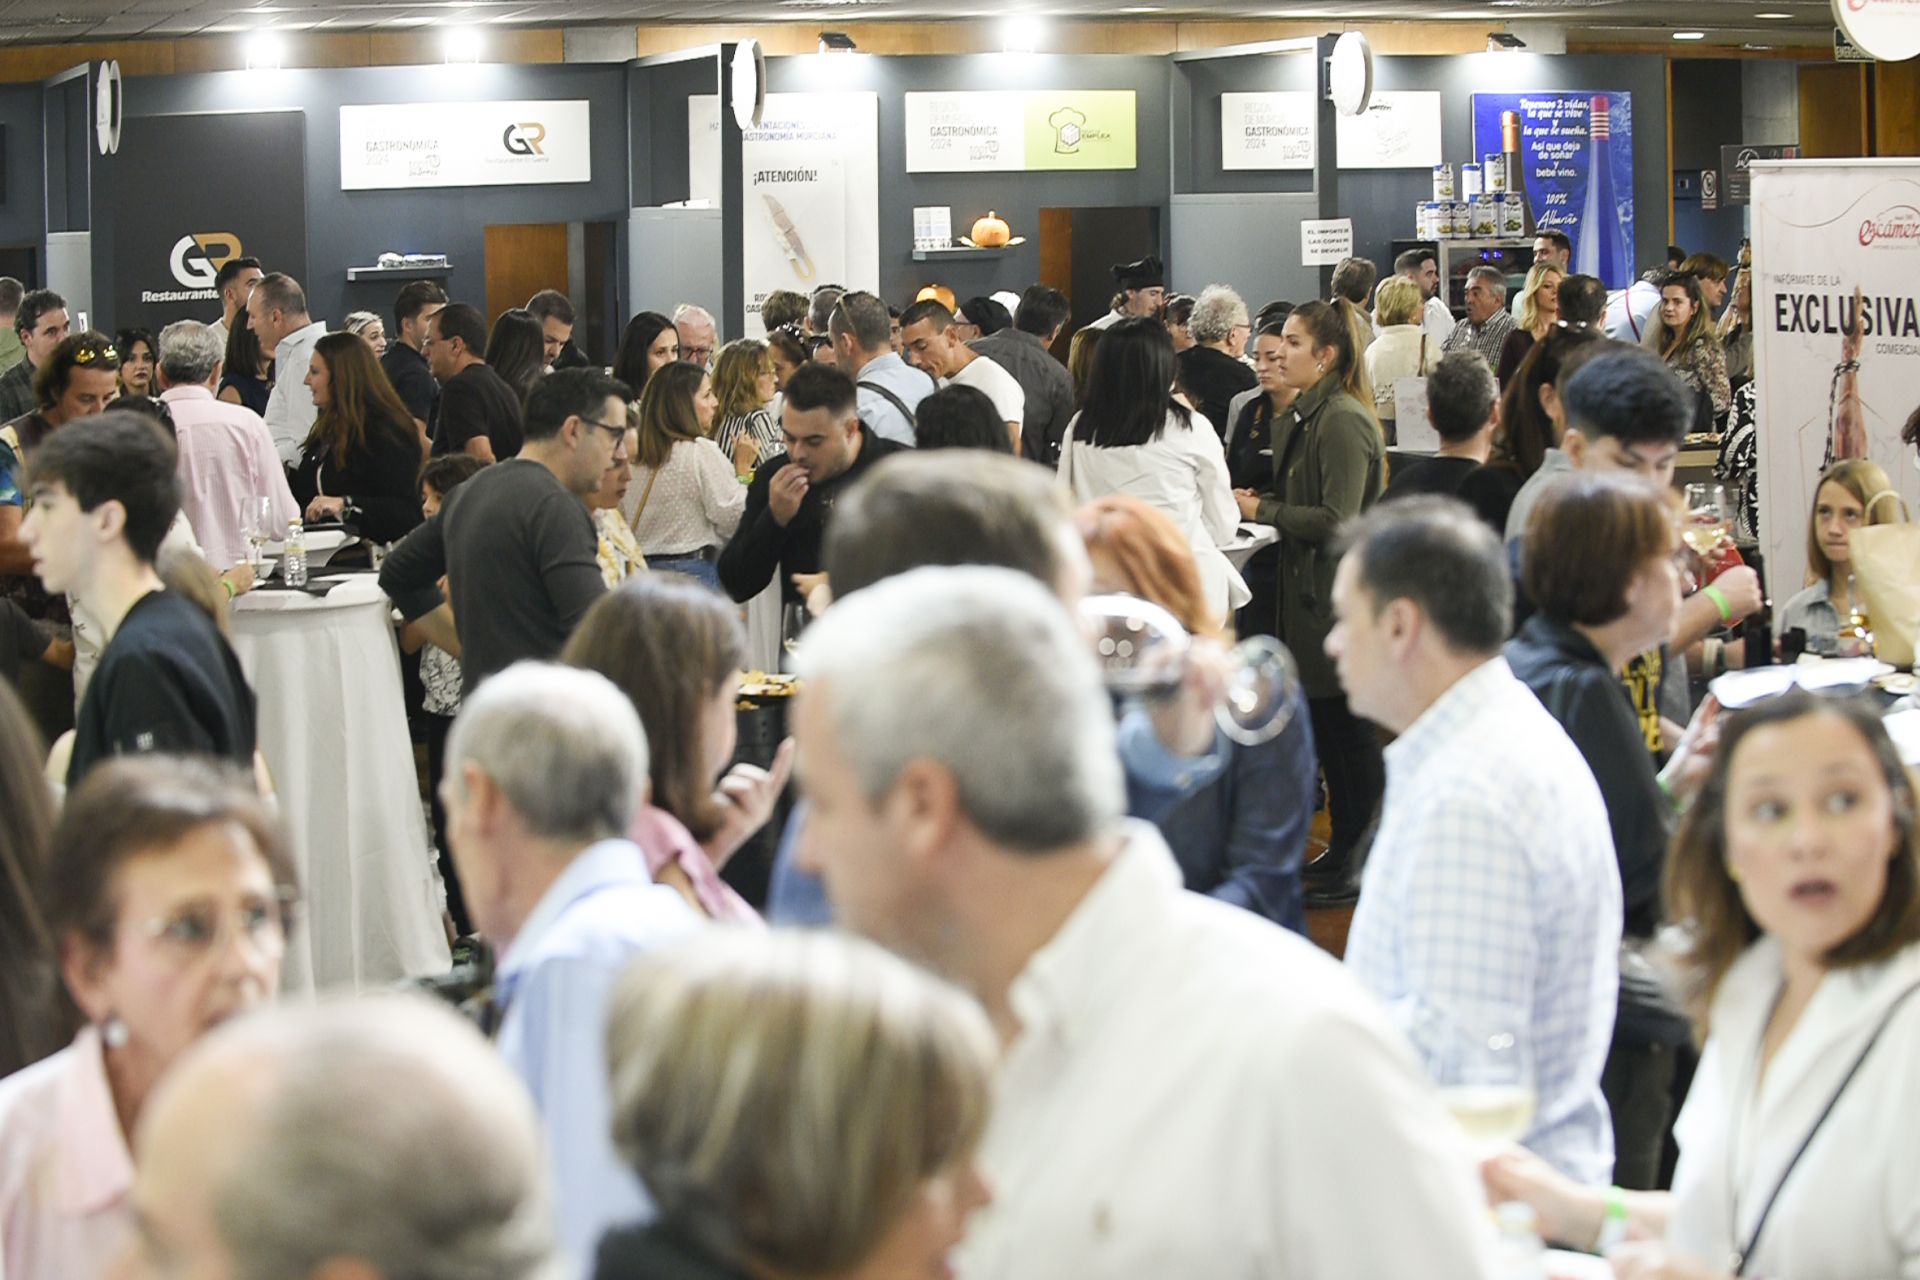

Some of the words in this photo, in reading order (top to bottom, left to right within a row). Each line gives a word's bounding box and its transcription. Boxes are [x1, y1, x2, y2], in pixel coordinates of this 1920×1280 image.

[1557, 98, 1564, 109] 2
[1545, 143, 1562, 153] que
[1537, 150, 1549, 160] de
[753, 165, 819, 187] ¡ATENCIÓN!
[1536, 167, 1556, 178] bebe
[1557, 168, 1578, 177] vino.
[1546, 193, 1568, 205] 100%
[1774, 293, 1920, 338] EXCLUSIVA
